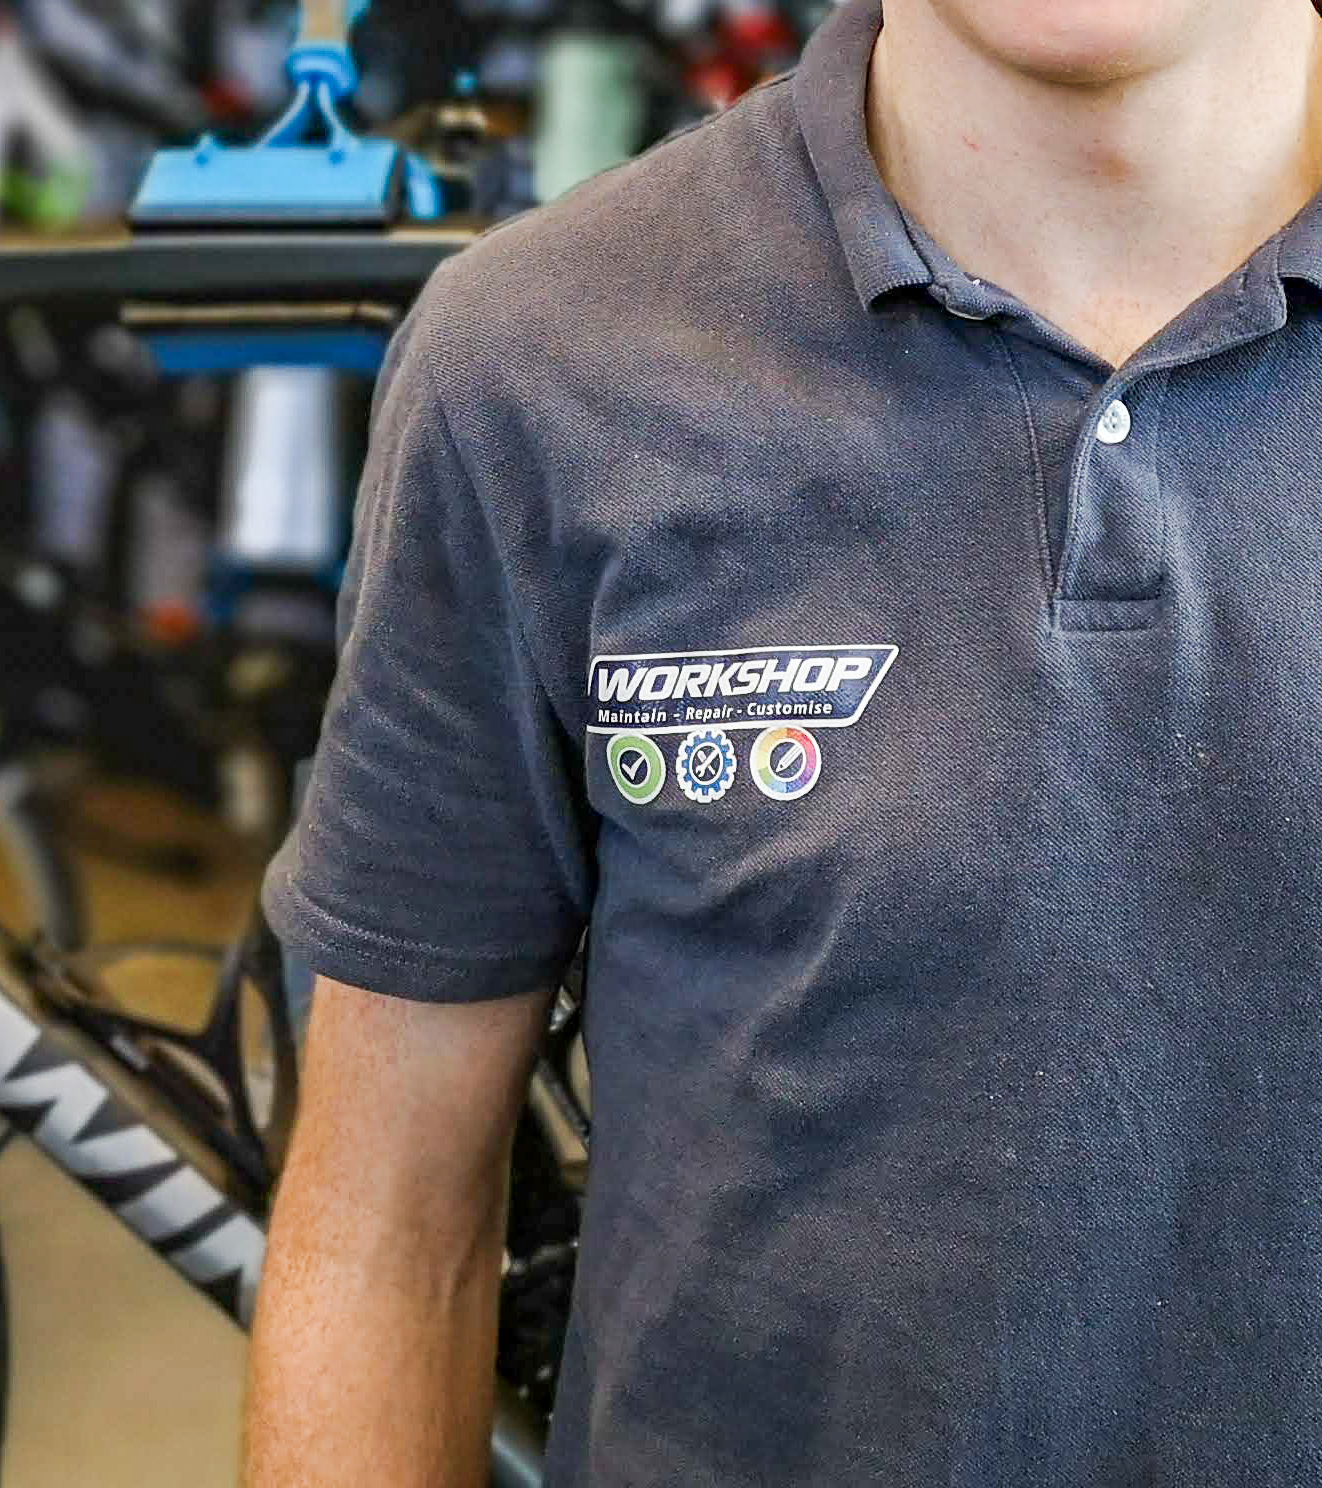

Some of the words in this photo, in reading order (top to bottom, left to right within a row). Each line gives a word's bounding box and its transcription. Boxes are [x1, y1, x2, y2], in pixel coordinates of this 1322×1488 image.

[597, 657, 873, 702] WORKSHOP
[598, 709, 667, 724] Maintain
[685, 706, 733, 722] Repair
[747, 701, 833, 717] Customise
